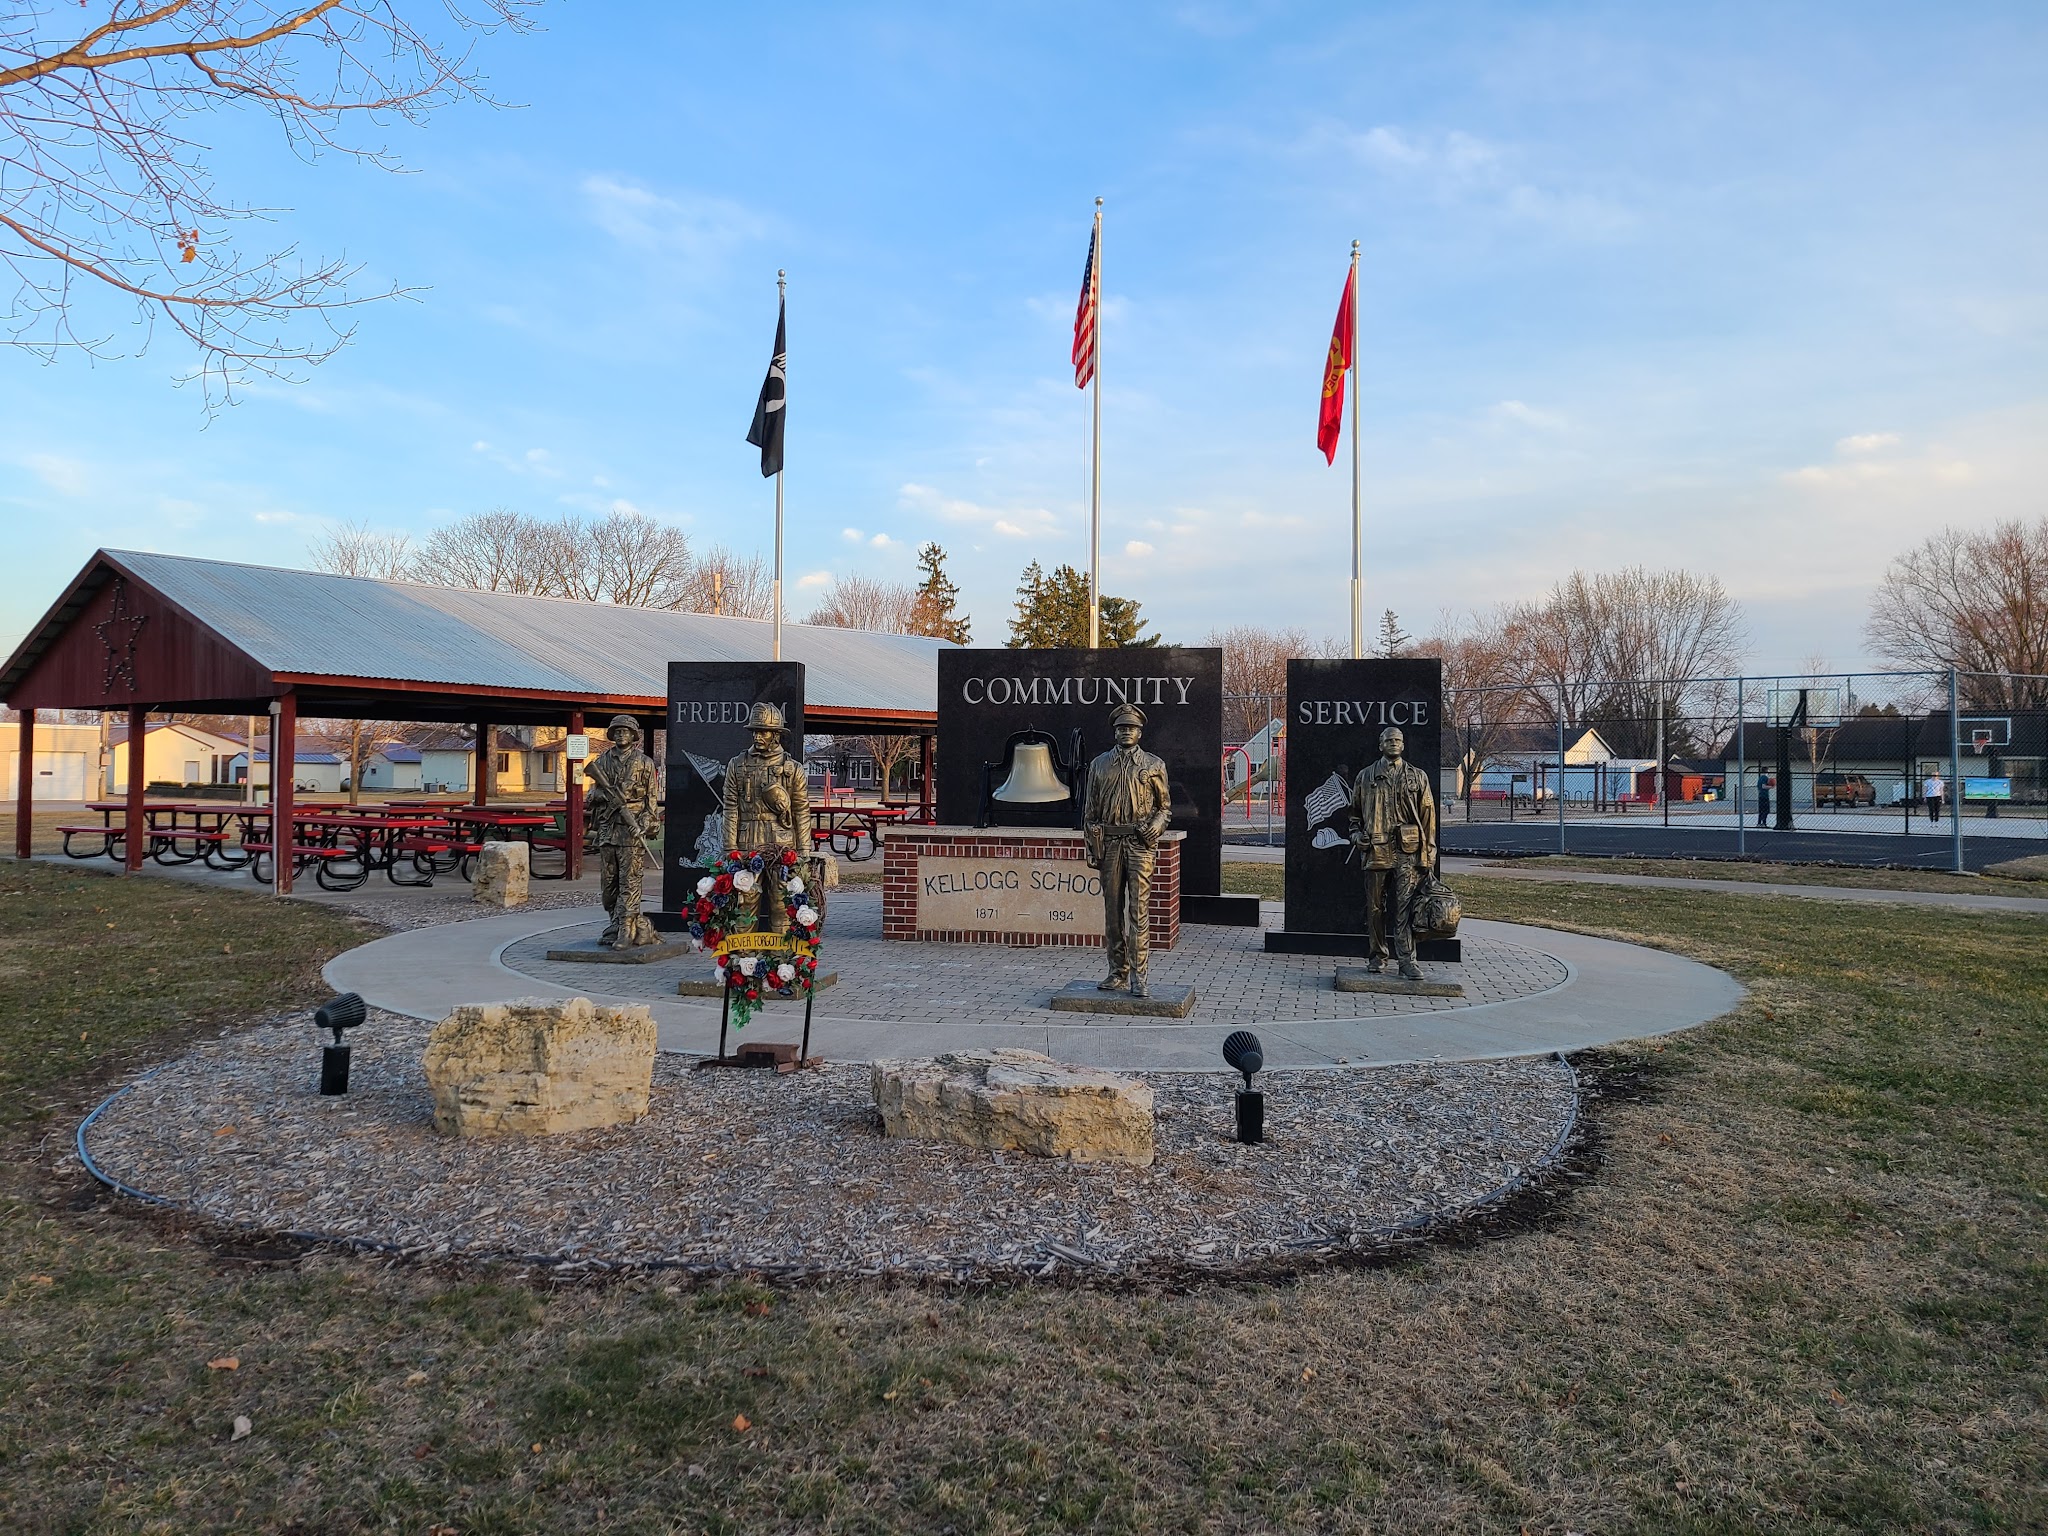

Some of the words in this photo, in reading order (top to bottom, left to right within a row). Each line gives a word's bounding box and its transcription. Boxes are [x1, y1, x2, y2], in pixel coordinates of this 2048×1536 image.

[962, 677, 1196, 705] COMMUNITY
[1299, 701, 1429, 725] SERVICE
[924, 870, 1019, 897] KELLOGG
[1030, 870, 1103, 897] SCHOO
[975, 908, 1000, 920] 1871
[1048, 910, 1075, 922] 1994
[728, 935, 751, 949] NEVER
